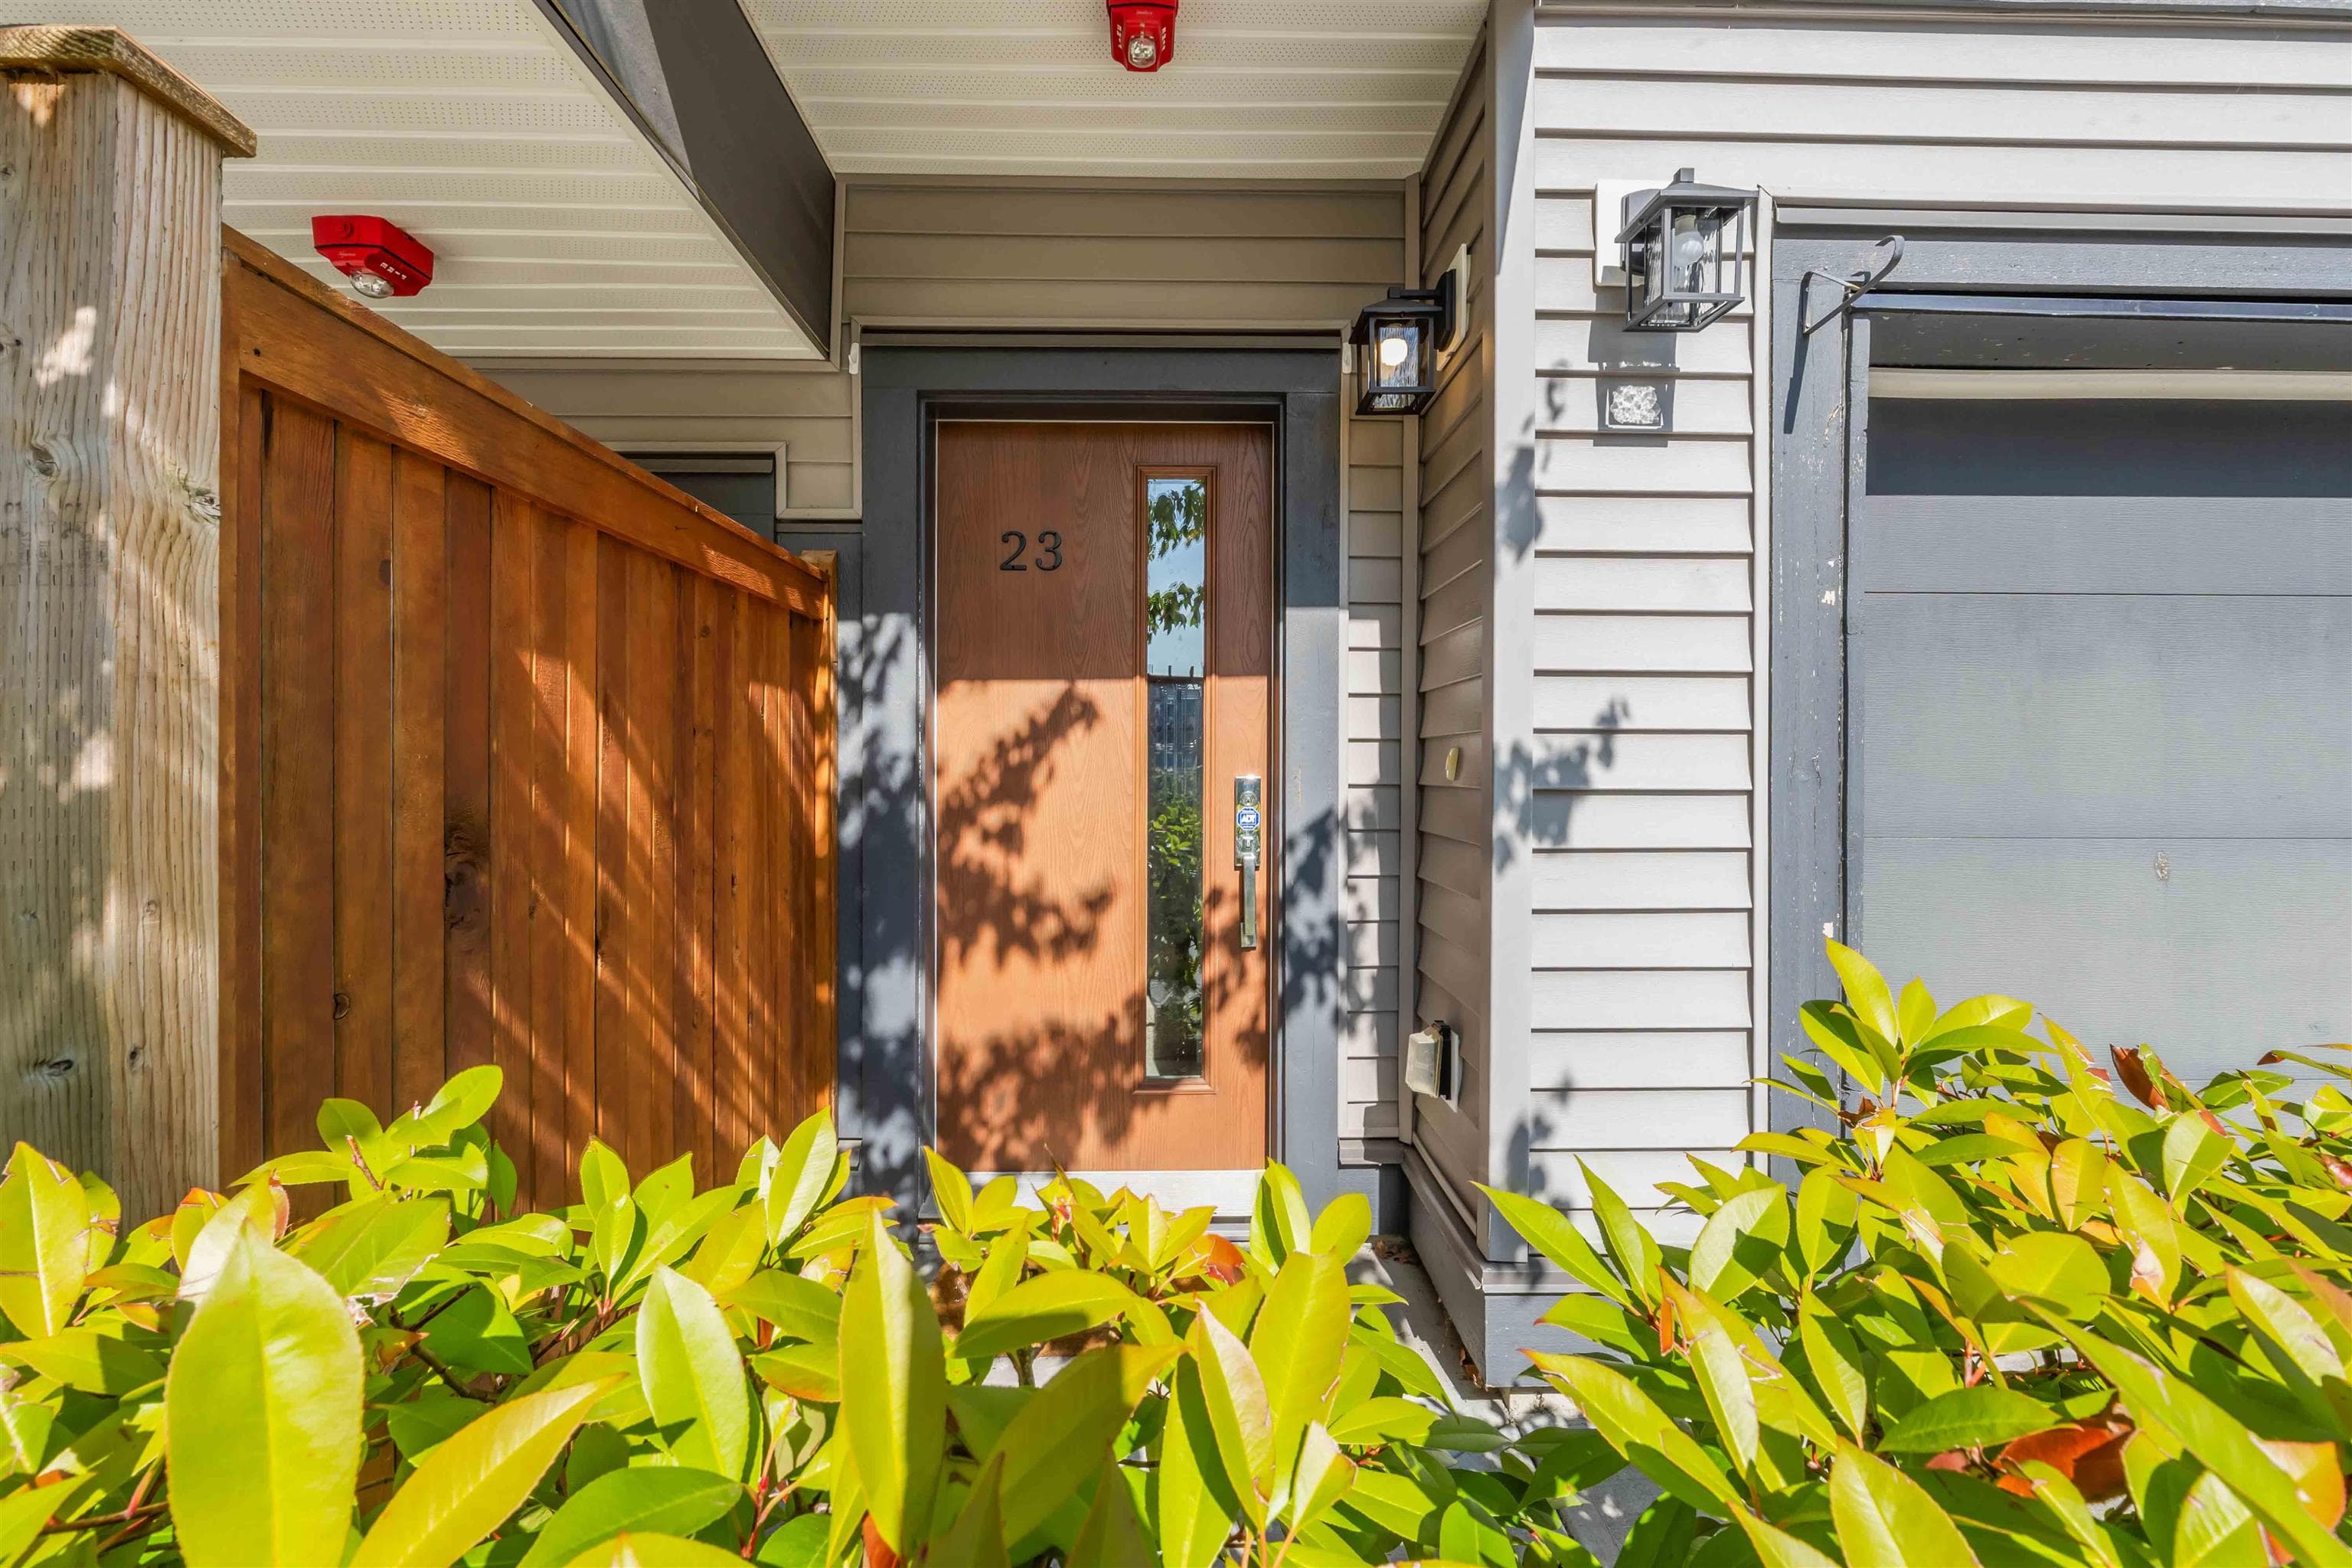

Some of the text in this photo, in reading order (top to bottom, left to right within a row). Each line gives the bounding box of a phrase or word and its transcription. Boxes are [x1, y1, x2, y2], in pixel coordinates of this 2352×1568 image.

[380, 262, 408, 281] FIRE
[1000, 531, 1063, 571] 23
[1241, 814, 1256, 824] ADT
